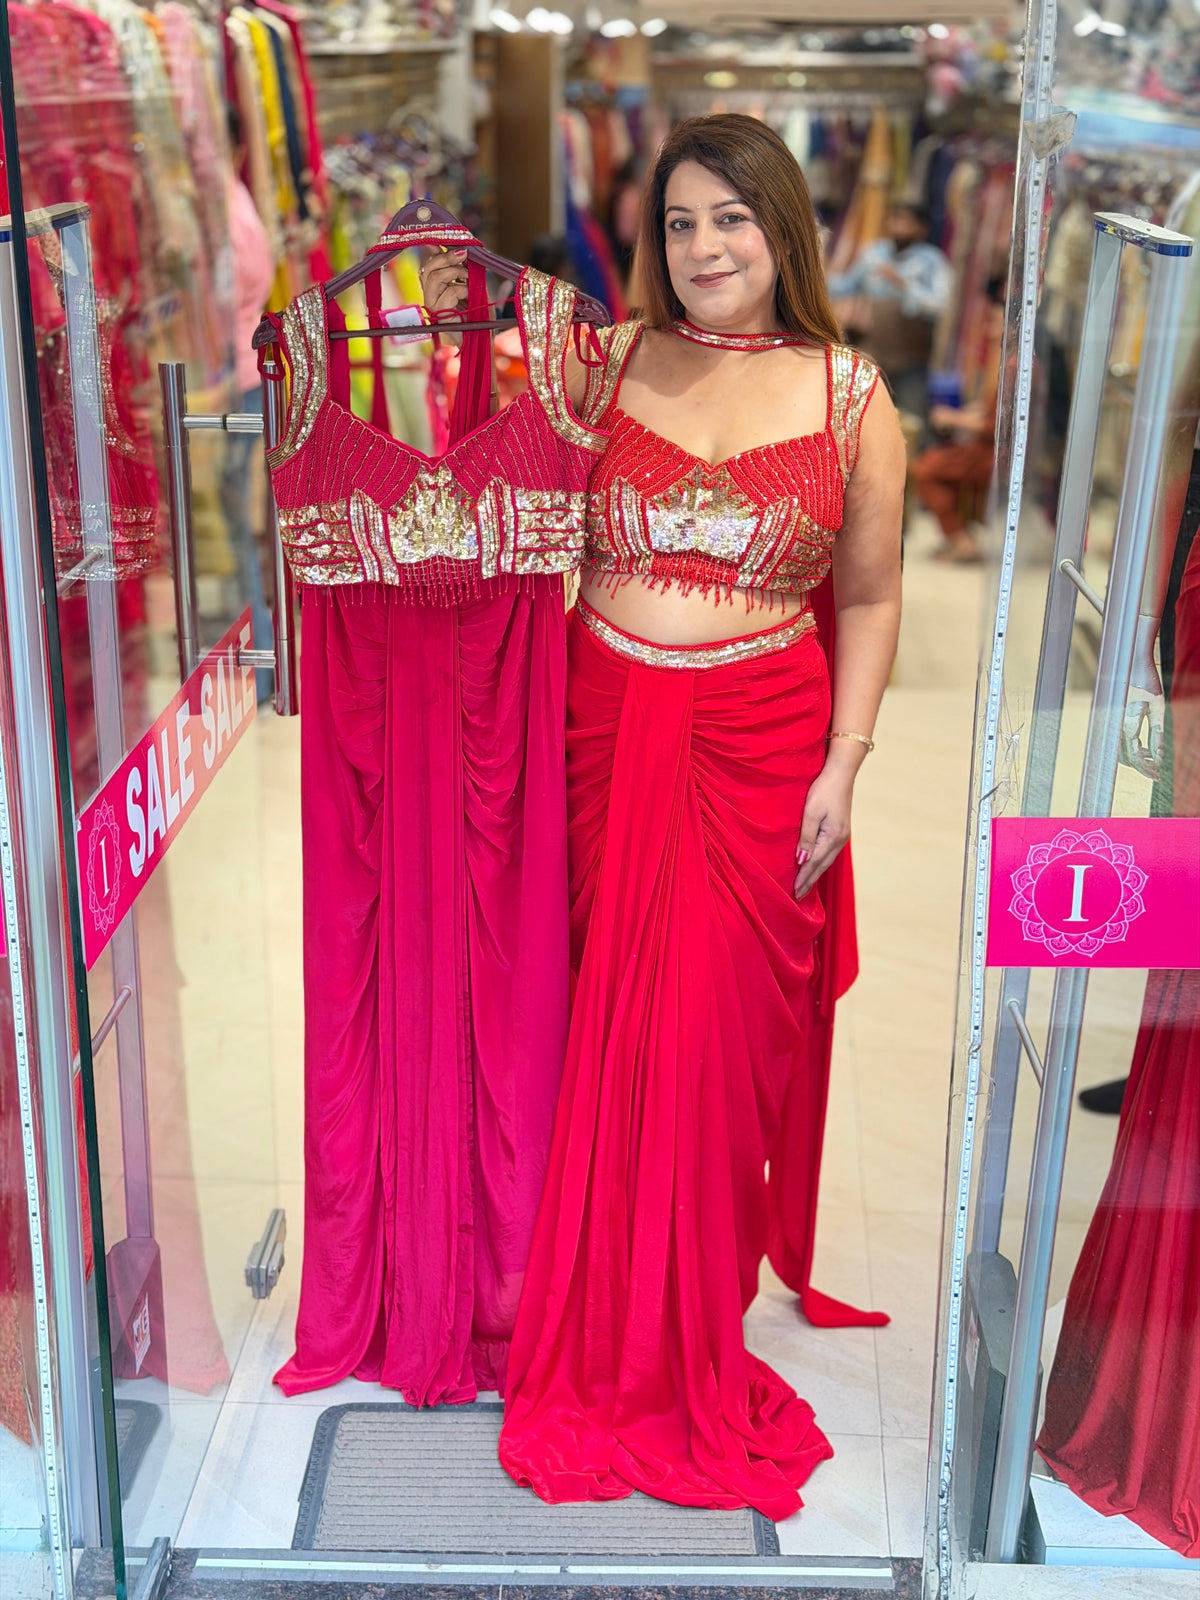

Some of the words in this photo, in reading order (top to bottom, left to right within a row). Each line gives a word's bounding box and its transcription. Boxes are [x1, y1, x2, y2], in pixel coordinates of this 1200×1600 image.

[99, 836, 111, 899] I
[125, 699, 196, 878] SALE
[200, 621, 256, 770] SALE
[1062, 864, 1094, 922] I
